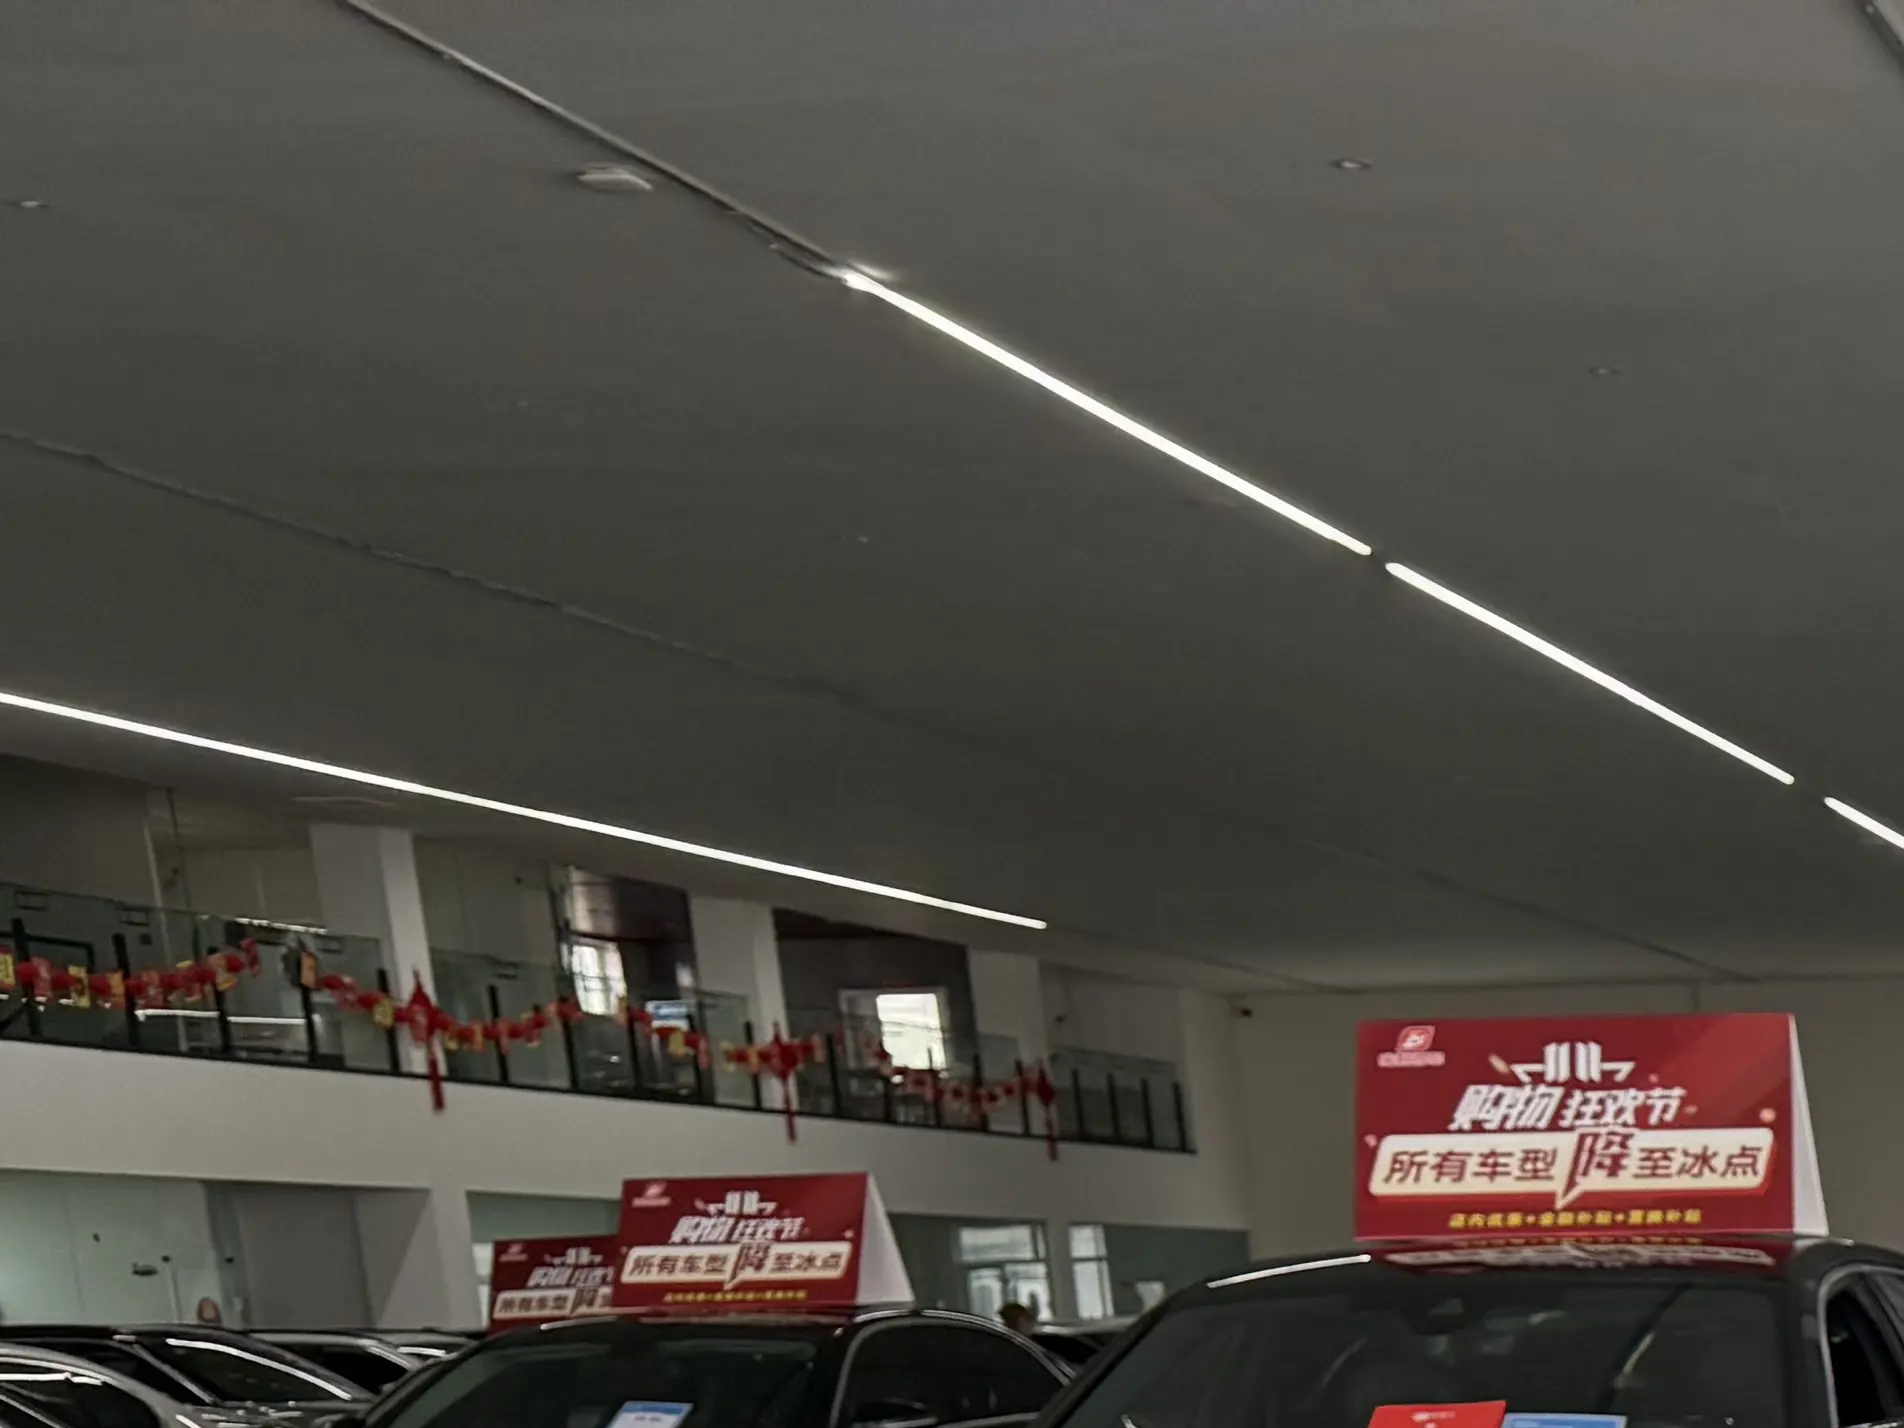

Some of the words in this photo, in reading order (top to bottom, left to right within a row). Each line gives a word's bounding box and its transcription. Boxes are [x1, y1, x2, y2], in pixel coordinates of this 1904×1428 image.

[1383, 1128, 1763, 1192] 所有车型降至冰点
